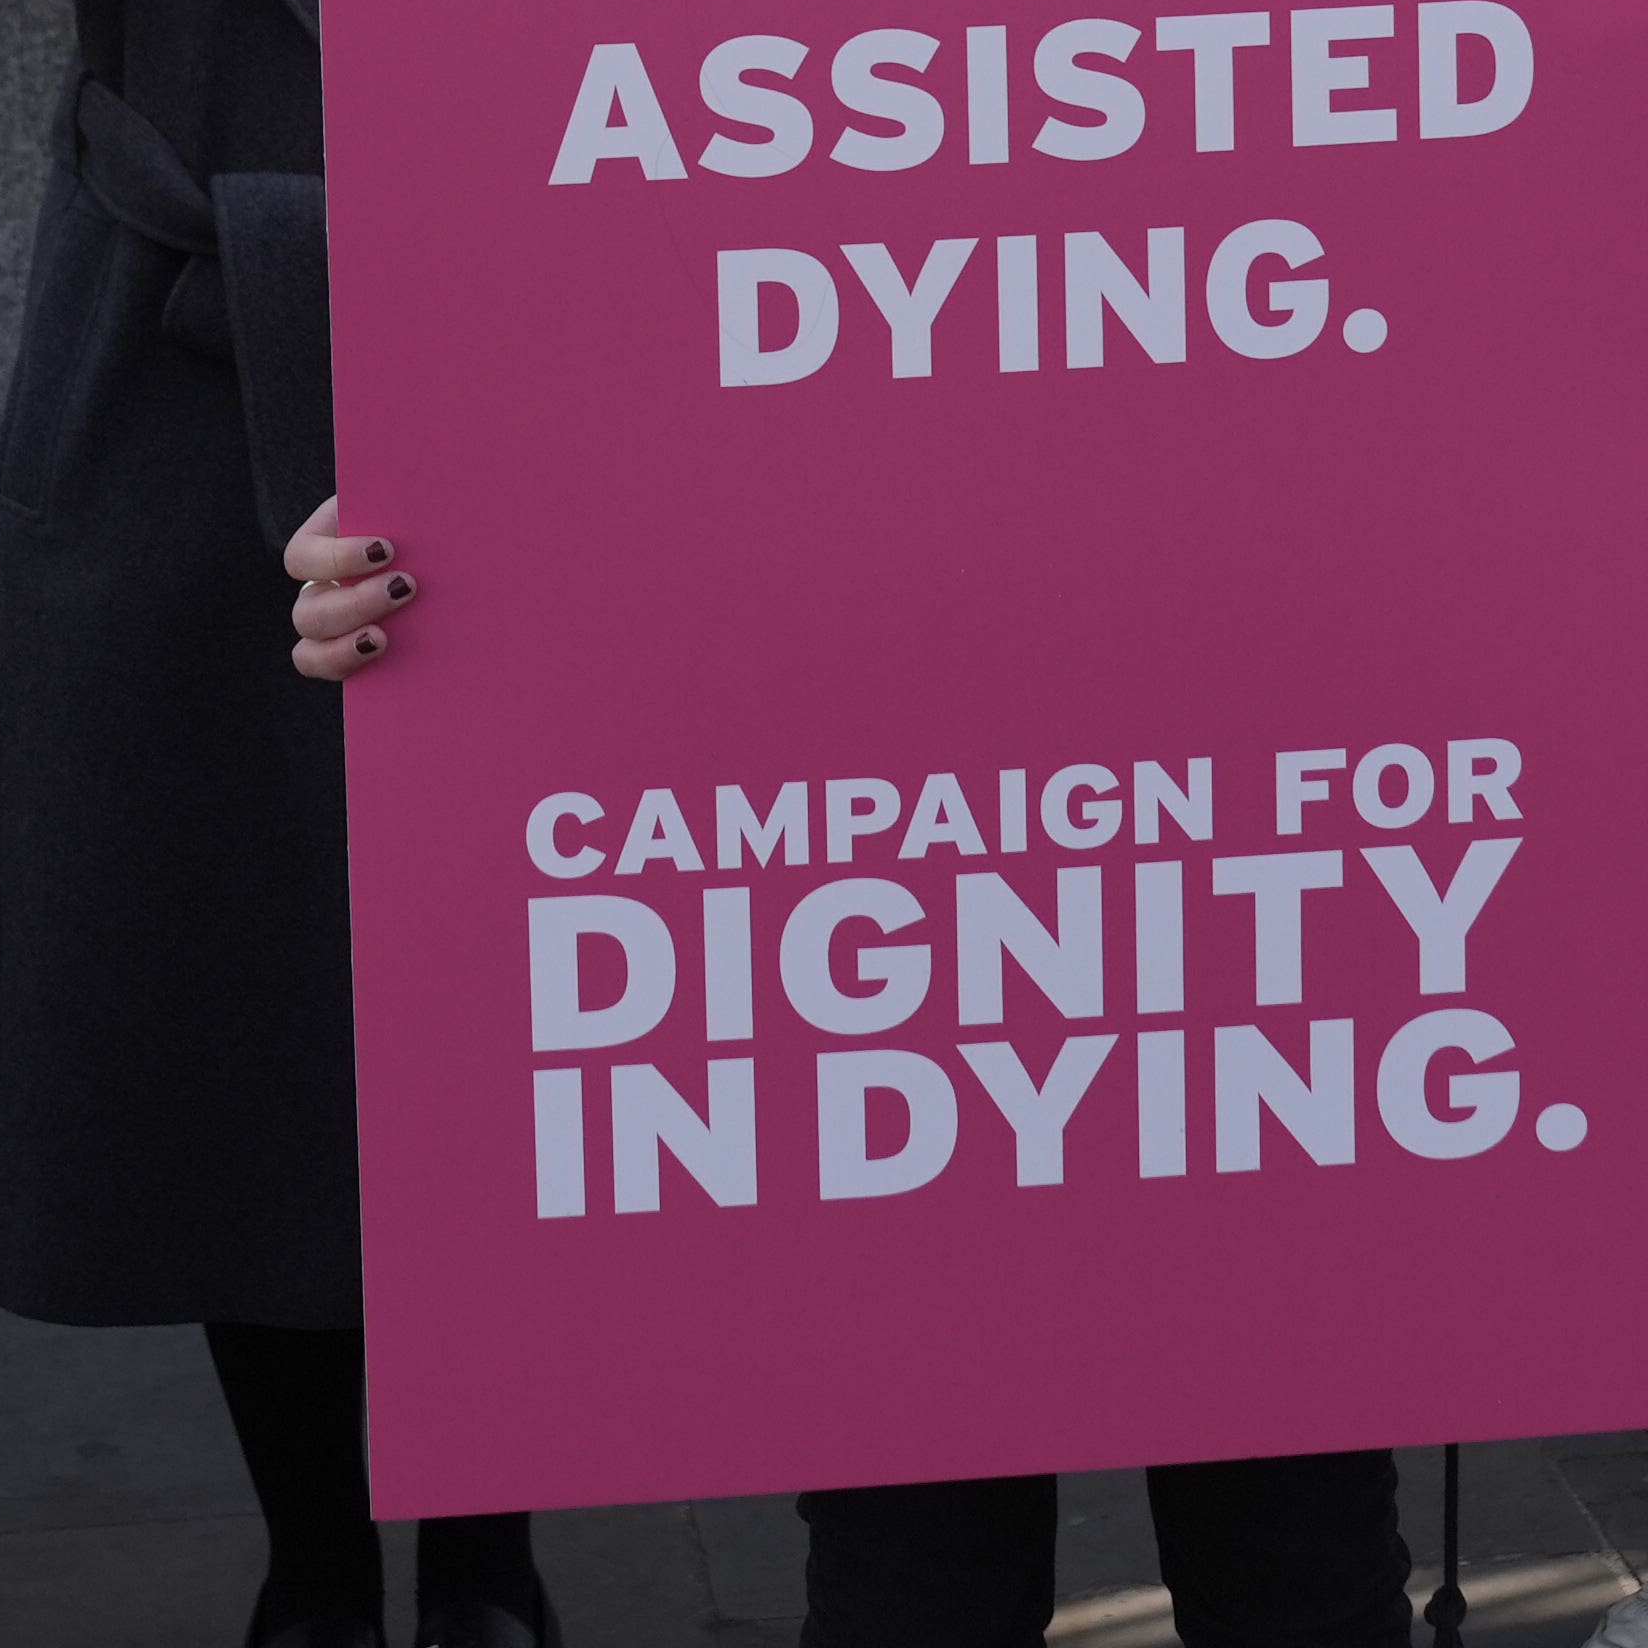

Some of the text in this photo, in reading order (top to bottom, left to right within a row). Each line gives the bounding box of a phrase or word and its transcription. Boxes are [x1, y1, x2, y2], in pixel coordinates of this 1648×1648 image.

[549, 1, 1533, 185] ASSISTED
[717, 220, 1387, 387] DYING.
[526, 739, 1522, 878] CAMPAIGN FOR
[528, 838, 1522, 1051] DIGNITY
[534, 1009, 1587, 1218] IN DYING.
